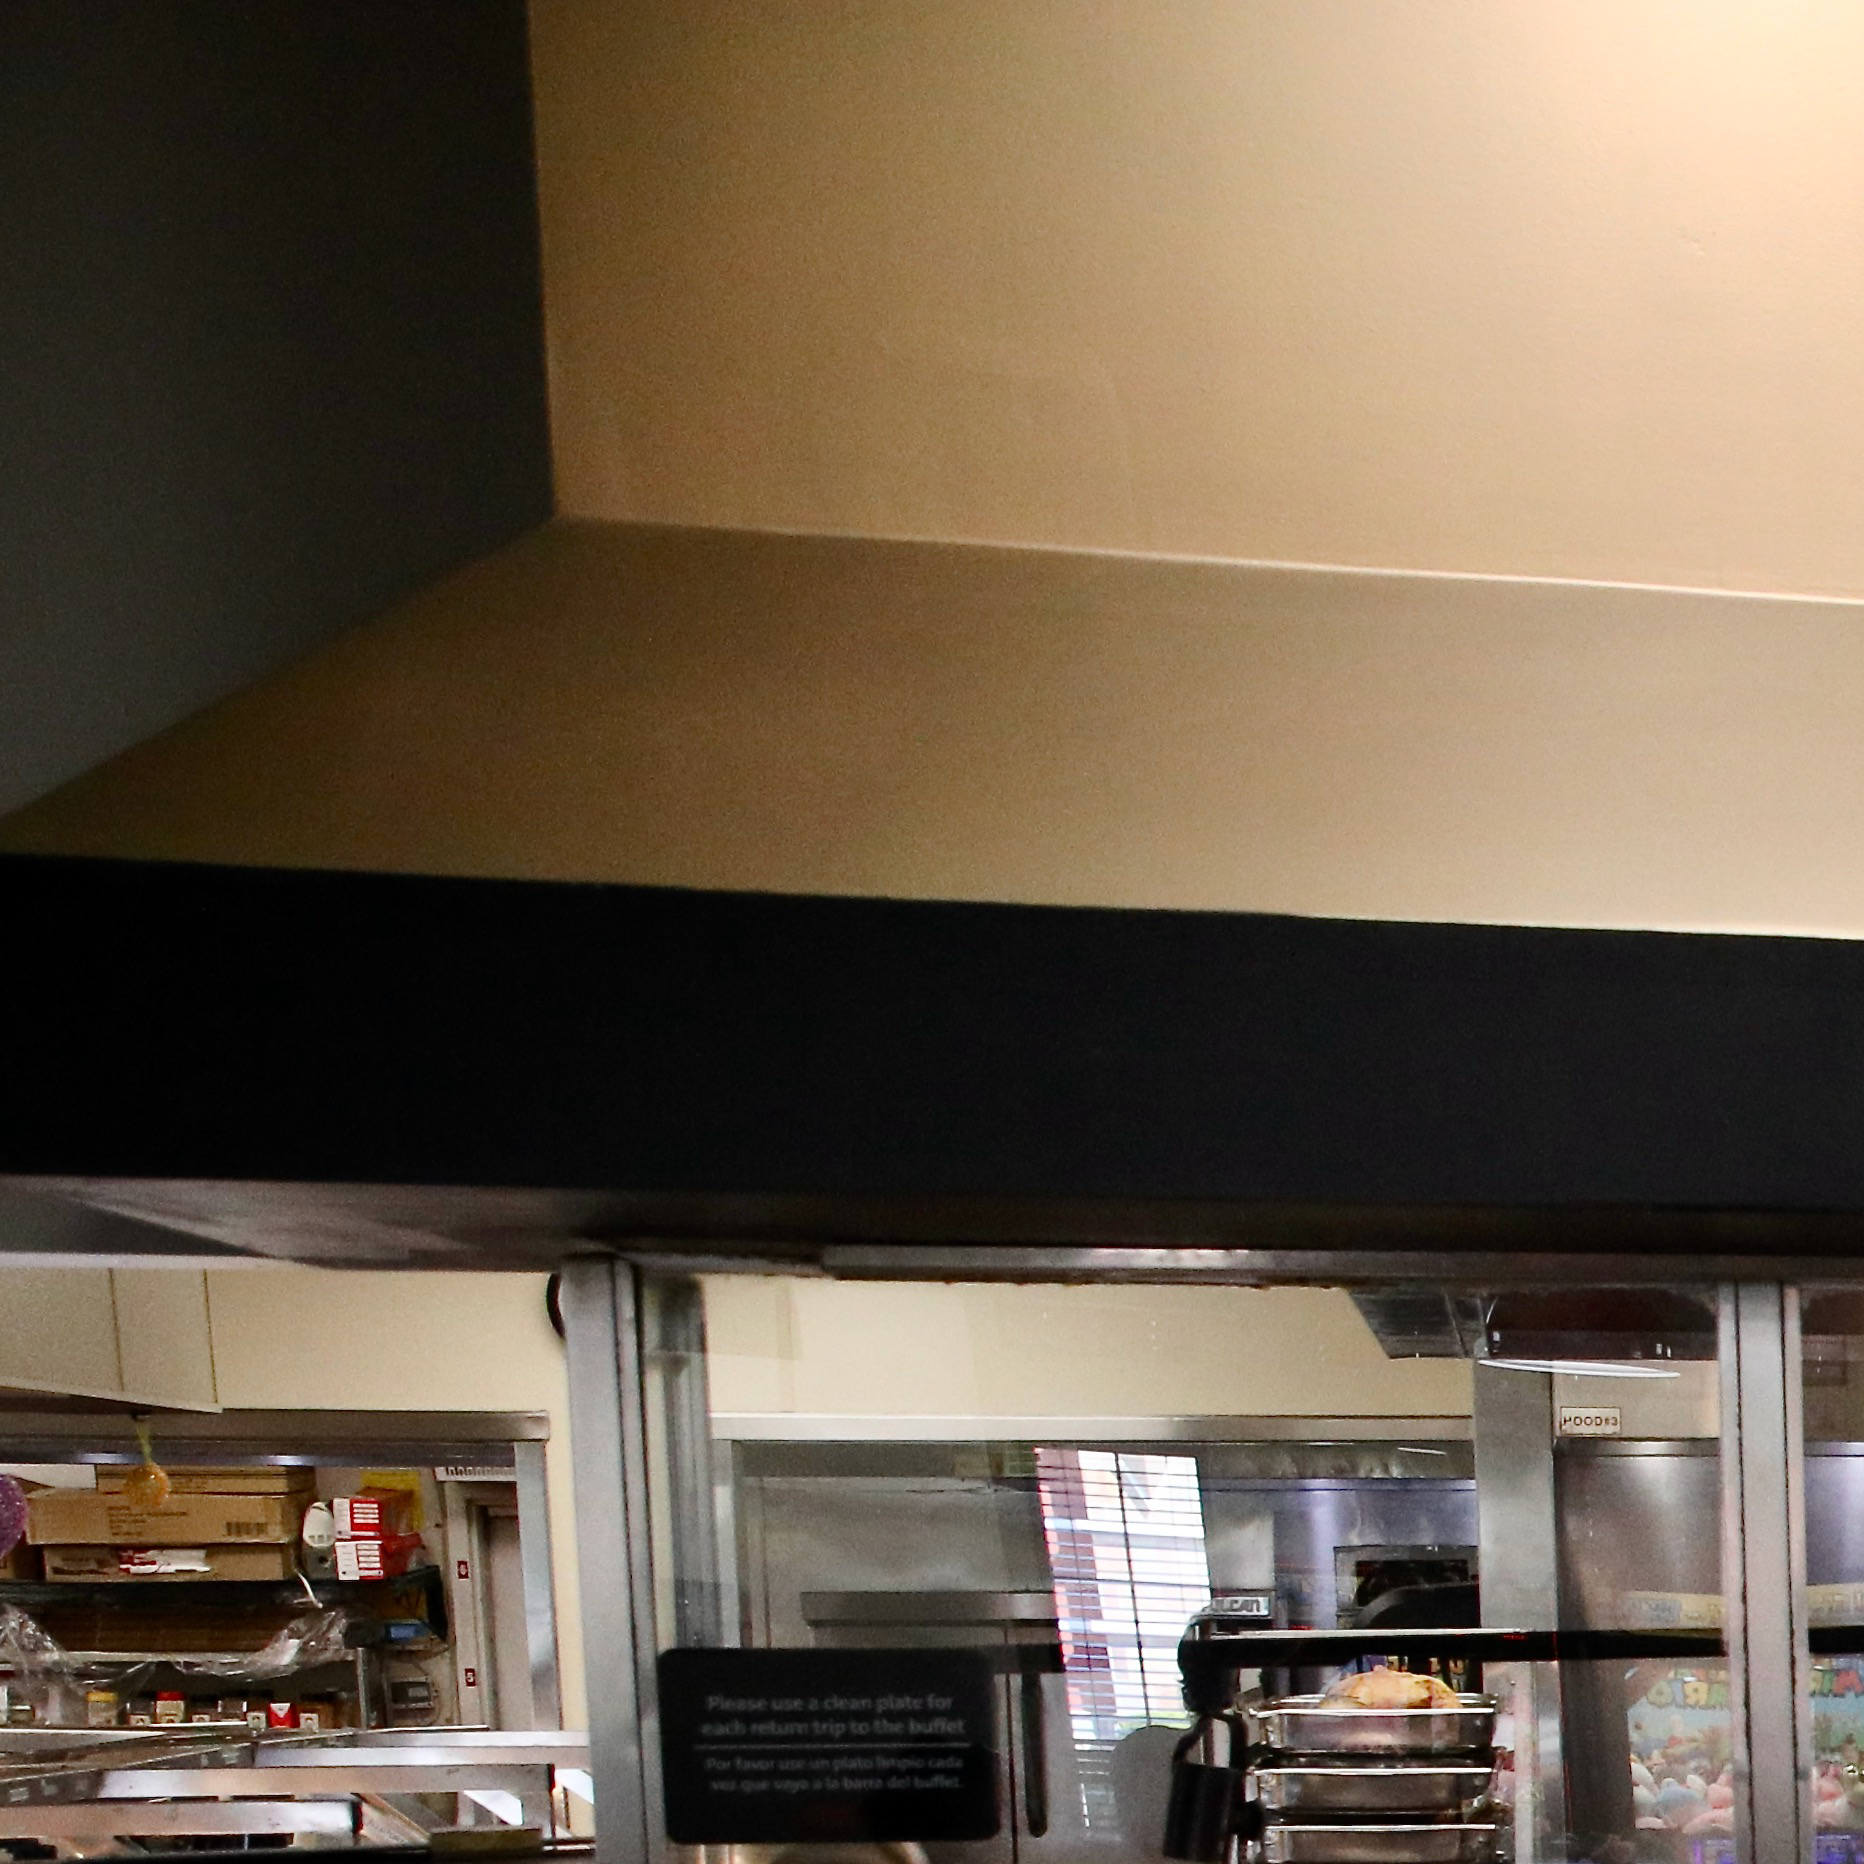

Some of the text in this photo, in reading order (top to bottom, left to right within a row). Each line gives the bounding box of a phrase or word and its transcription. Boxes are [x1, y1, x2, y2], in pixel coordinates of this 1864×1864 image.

[707, 1693, 953, 1714] Please use a clean plate for
[701, 1717, 967, 1737] each return trip to the buffet
